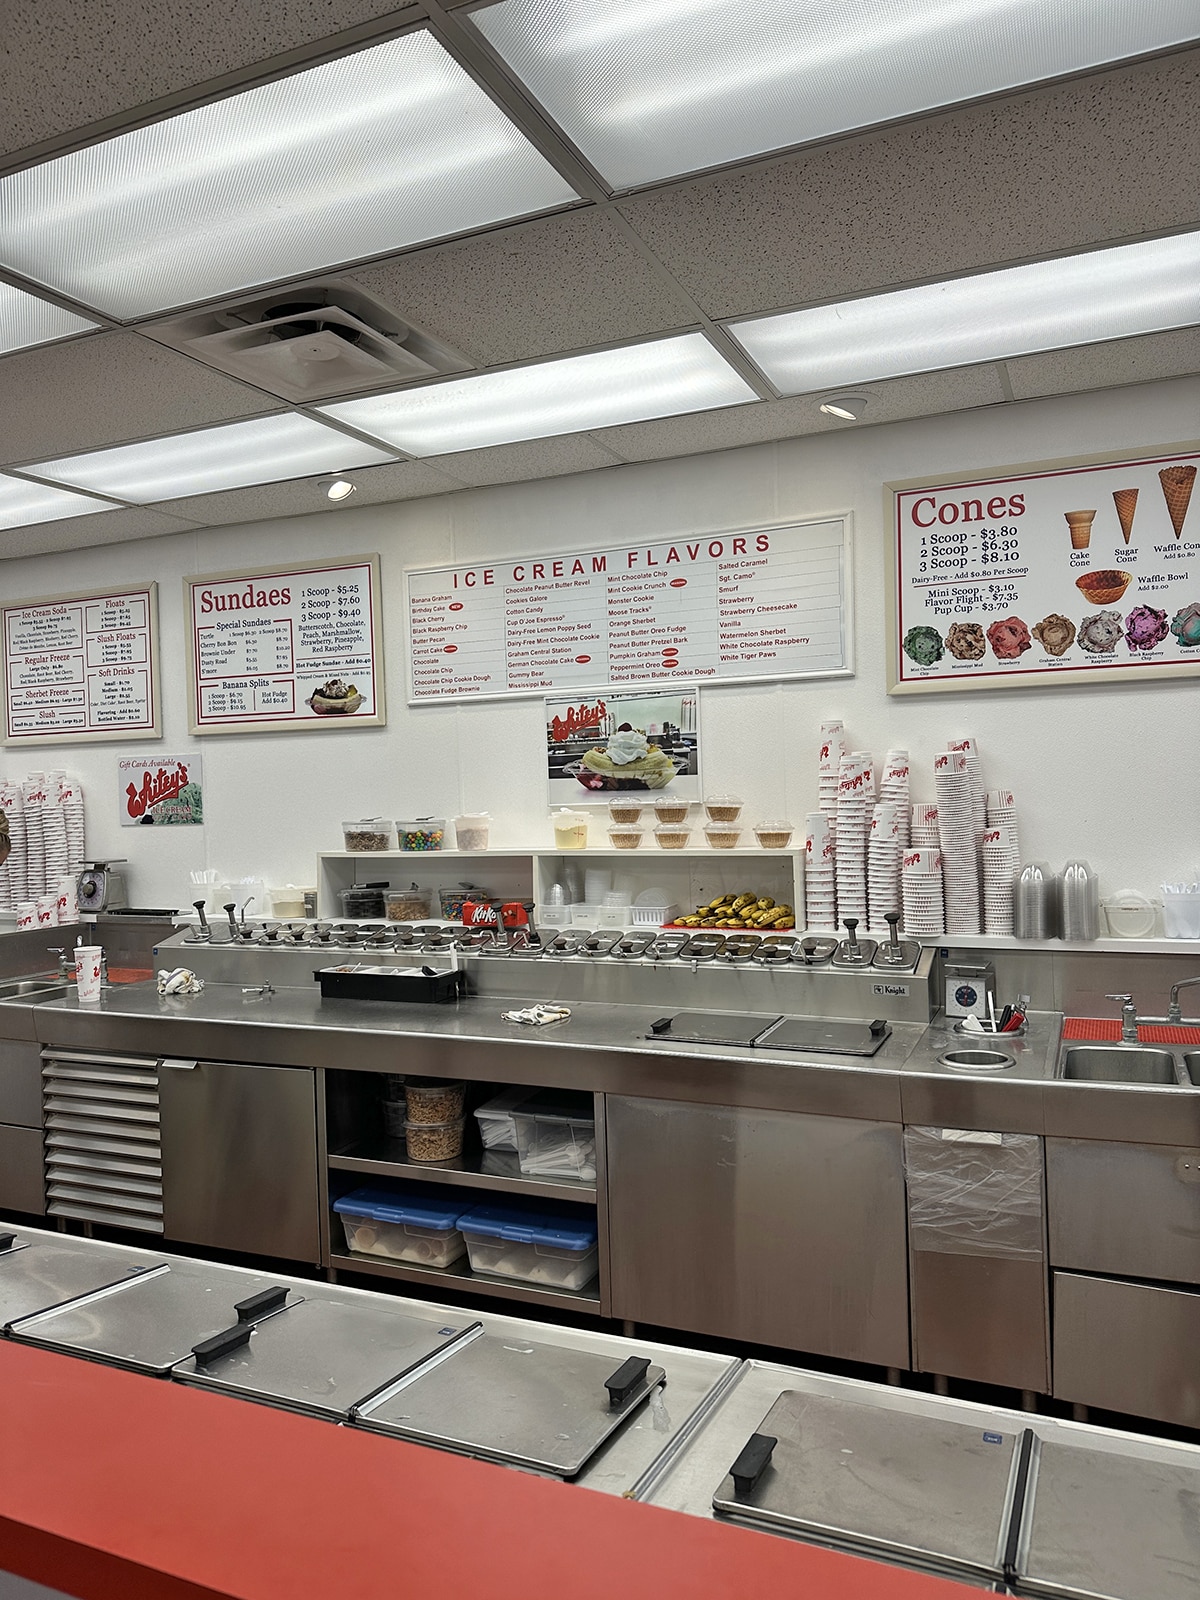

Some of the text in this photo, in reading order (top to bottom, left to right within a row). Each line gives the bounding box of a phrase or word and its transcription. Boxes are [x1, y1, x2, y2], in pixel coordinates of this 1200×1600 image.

[912, 493, 1026, 528] Cones
[930, 534, 967, 547] Scoop
[980, 527, 1017, 540] $3.80
[921, 539, 1018, 560] 2 Scoop $6.30
[1114, 549, 1139, 557] Sugar
[1154, 544, 1181, 552] Waffle
[454, 534, 770, 588] ICE CREAM FLAVORS
[740, 559, 768, 567] Caramel
[920, 552, 1019, 572] 3 Scoop $8.10
[912, 575, 948, 583] Dairy-Free
[1138, 572, 1188, 583] Waffle Bowl
[337, 586, 359, 594] $5.25
[928, 584, 1014, 599] Mini Scoop $3.10
[201, 584, 291, 614] Sundaes
[308, 600, 330, 608] Scoop
[338, 597, 360, 606] $7.60
[925, 593, 1018, 608] Flavor Flight $7.35
[52, 606, 67, 615] Soda
[757, 604, 797, 612] Cheesecake
[934, 607, 952, 615] Pup
[982, 602, 1008, 611] $3.70
[301, 609, 361, 622] 3 Scoop $9.40
[216, 619, 271, 631] Special Sundaes
[298, 622, 335, 631] Butterscotch,
[97, 634, 115, 643] Slush
[334, 636, 364, 645] Pineapple,
[24, 656, 49, 665] Regular
[99, 667, 135, 677] Soft Drinks
[249, 679, 269, 689] Splits
[26, 690, 48, 698] Sherbet
[552, 699, 607, 742] Whitey's
[120, 761, 131, 770] Gift
[131, 760, 147, 768] Cards
[126, 762, 189, 818] Whitey's
[885, 986, 905, 994] Knight
